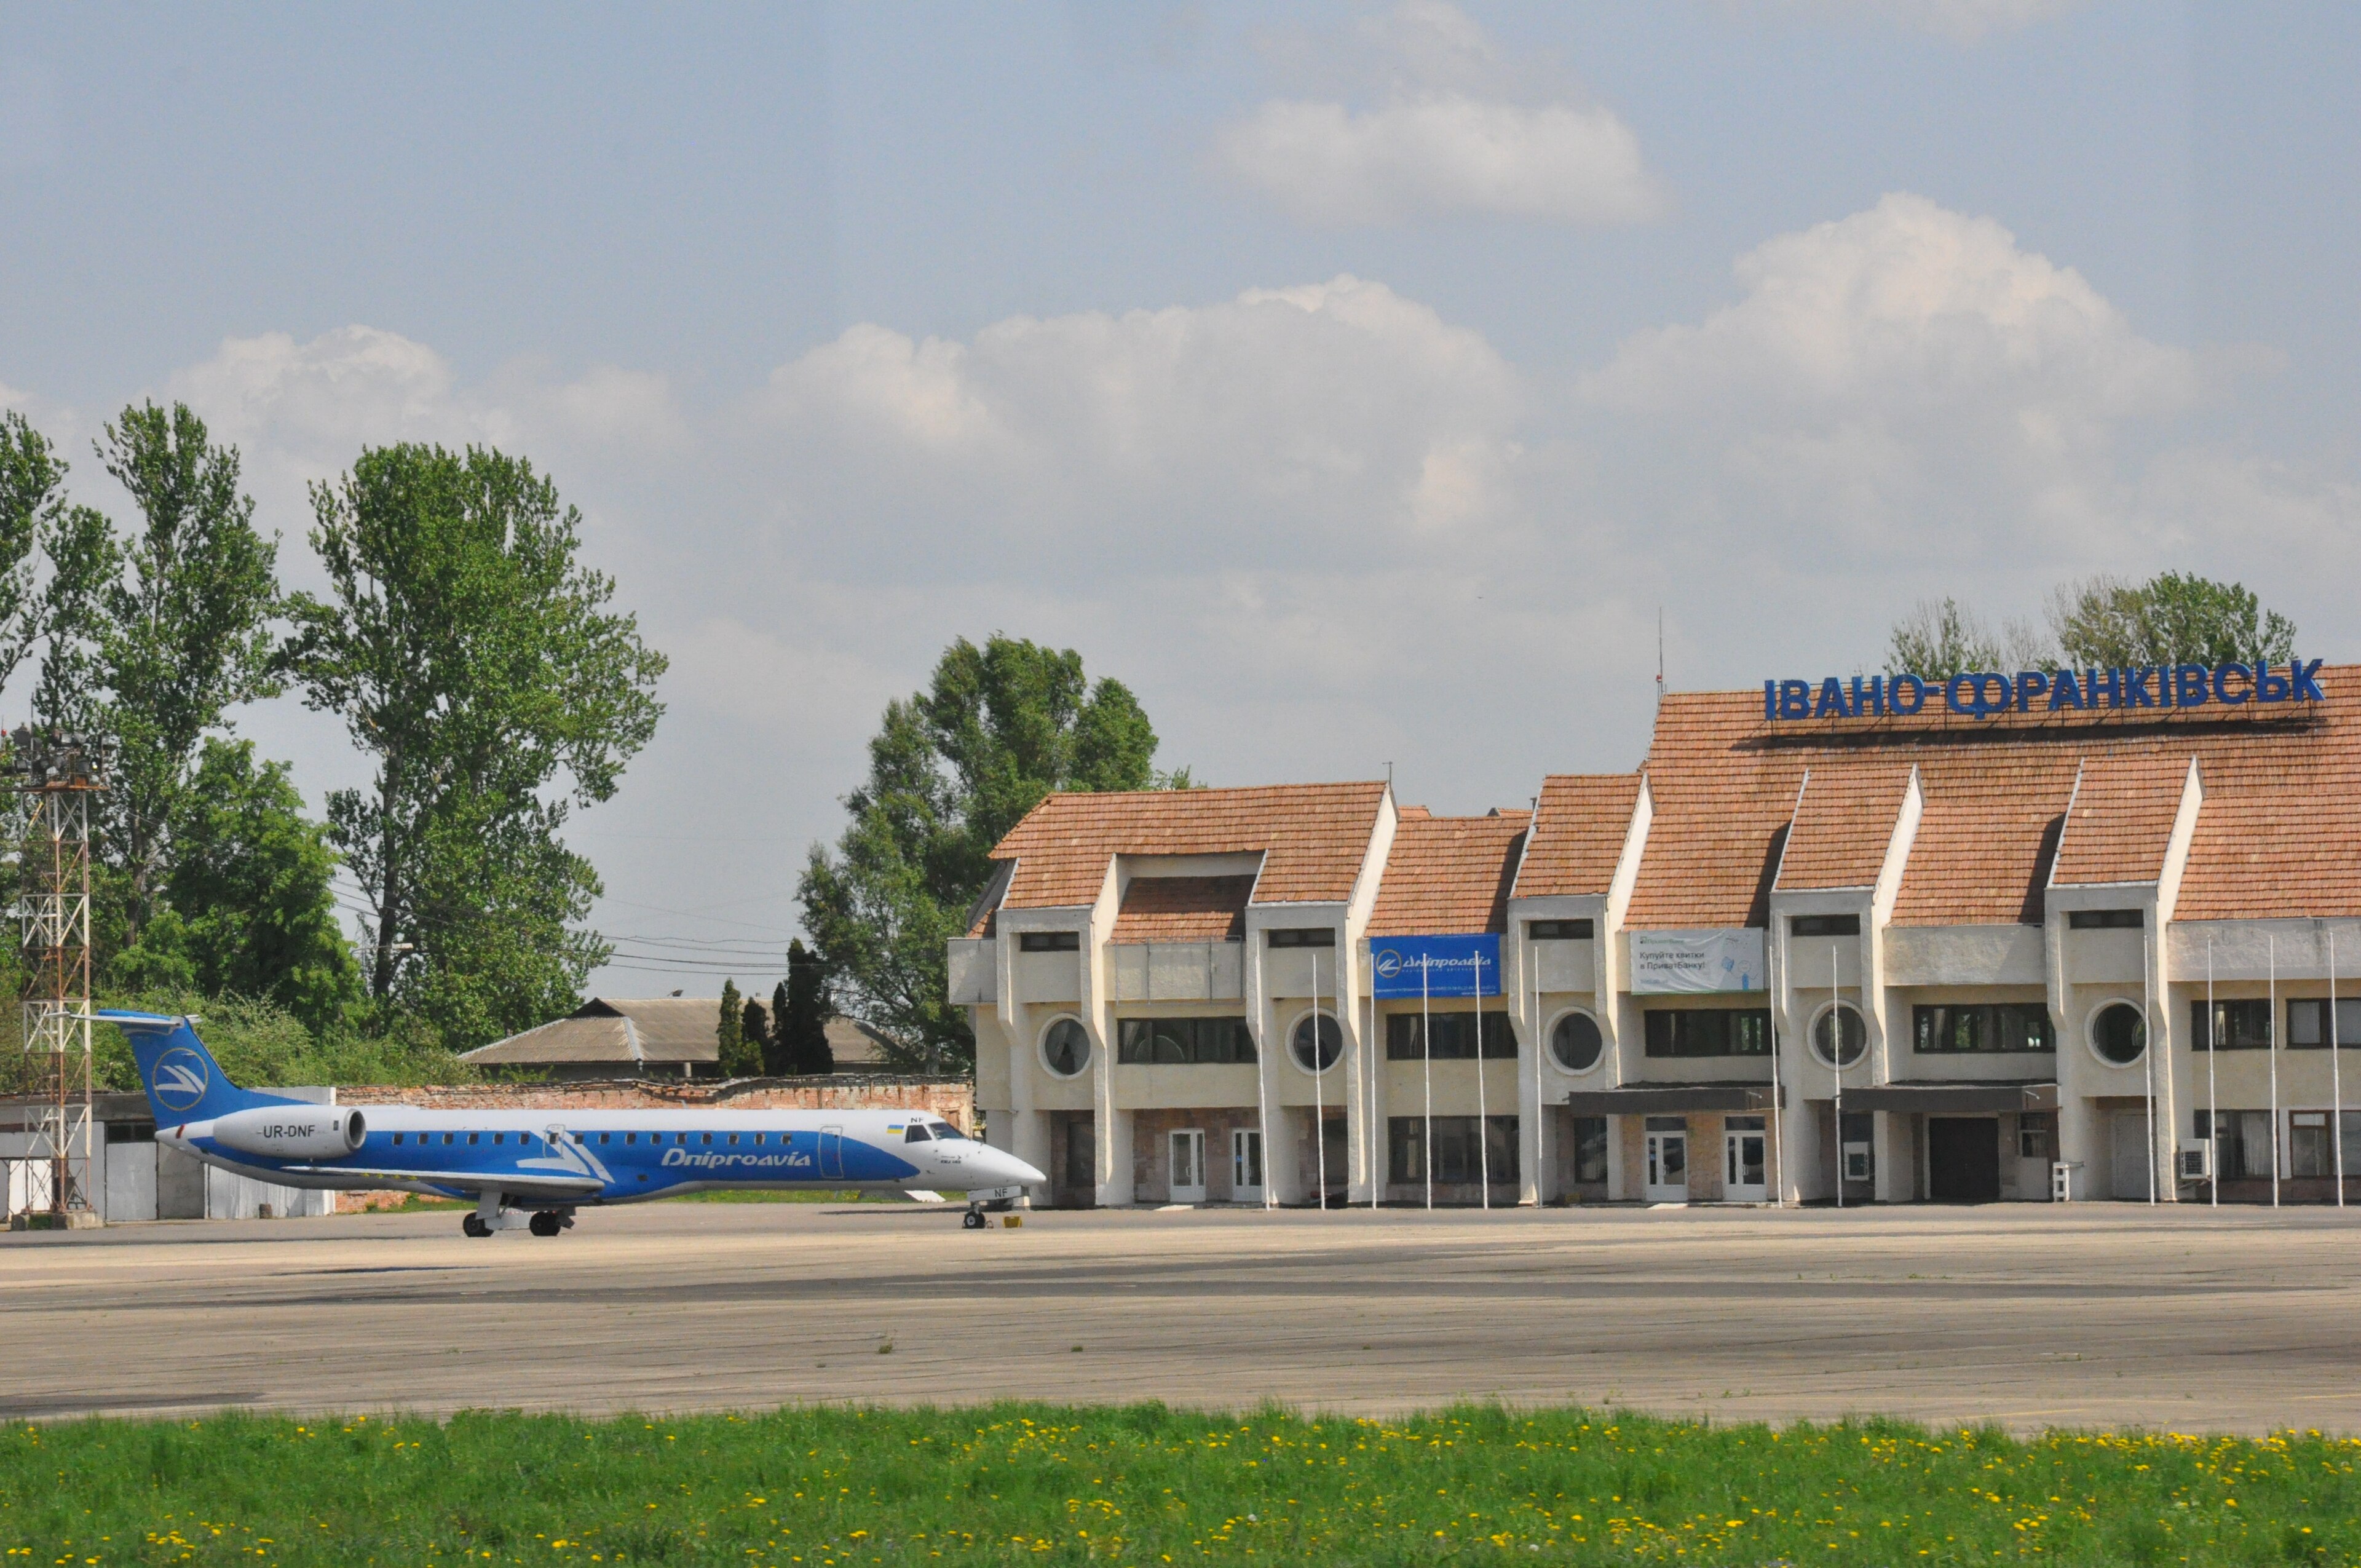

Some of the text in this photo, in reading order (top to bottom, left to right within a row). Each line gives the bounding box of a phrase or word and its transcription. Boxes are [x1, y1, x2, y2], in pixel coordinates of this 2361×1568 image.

[1765, 659, 2326, 721] ІВАНО-ФРАНКІВСЬК
[1640, 951, 1674, 960] Купуйте
[1647, 962, 1705, 970] ПриватБанку!
[263, 1125, 315, 1138] UR-DNF
[661, 1148, 811, 1168] Dniproavia
[994, 1188, 1008, 1198] NF
